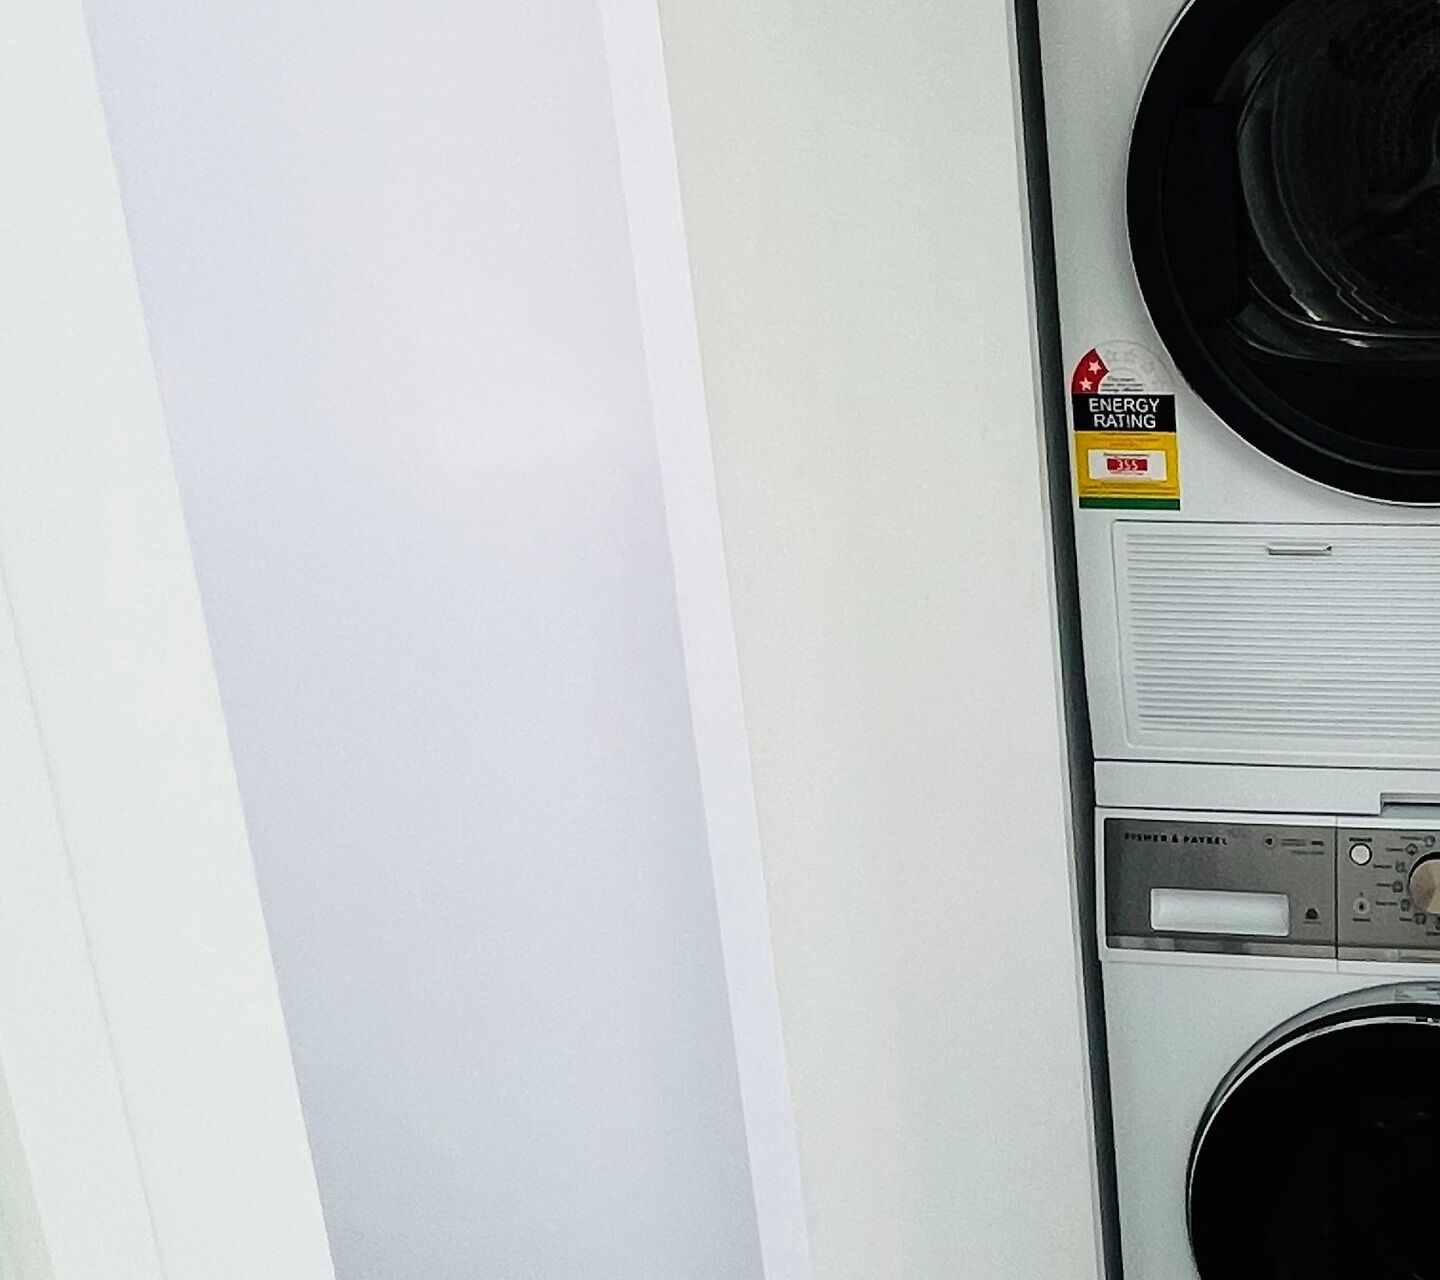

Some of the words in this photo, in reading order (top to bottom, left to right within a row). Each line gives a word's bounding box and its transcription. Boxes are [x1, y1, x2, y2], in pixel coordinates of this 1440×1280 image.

[1089, 397, 1160, 413] ENERGY
[1093, 414, 1156, 429] RATING
[1124, 832, 1168, 842] FISHER
[1183, 836, 1228, 846] PAYKEL
